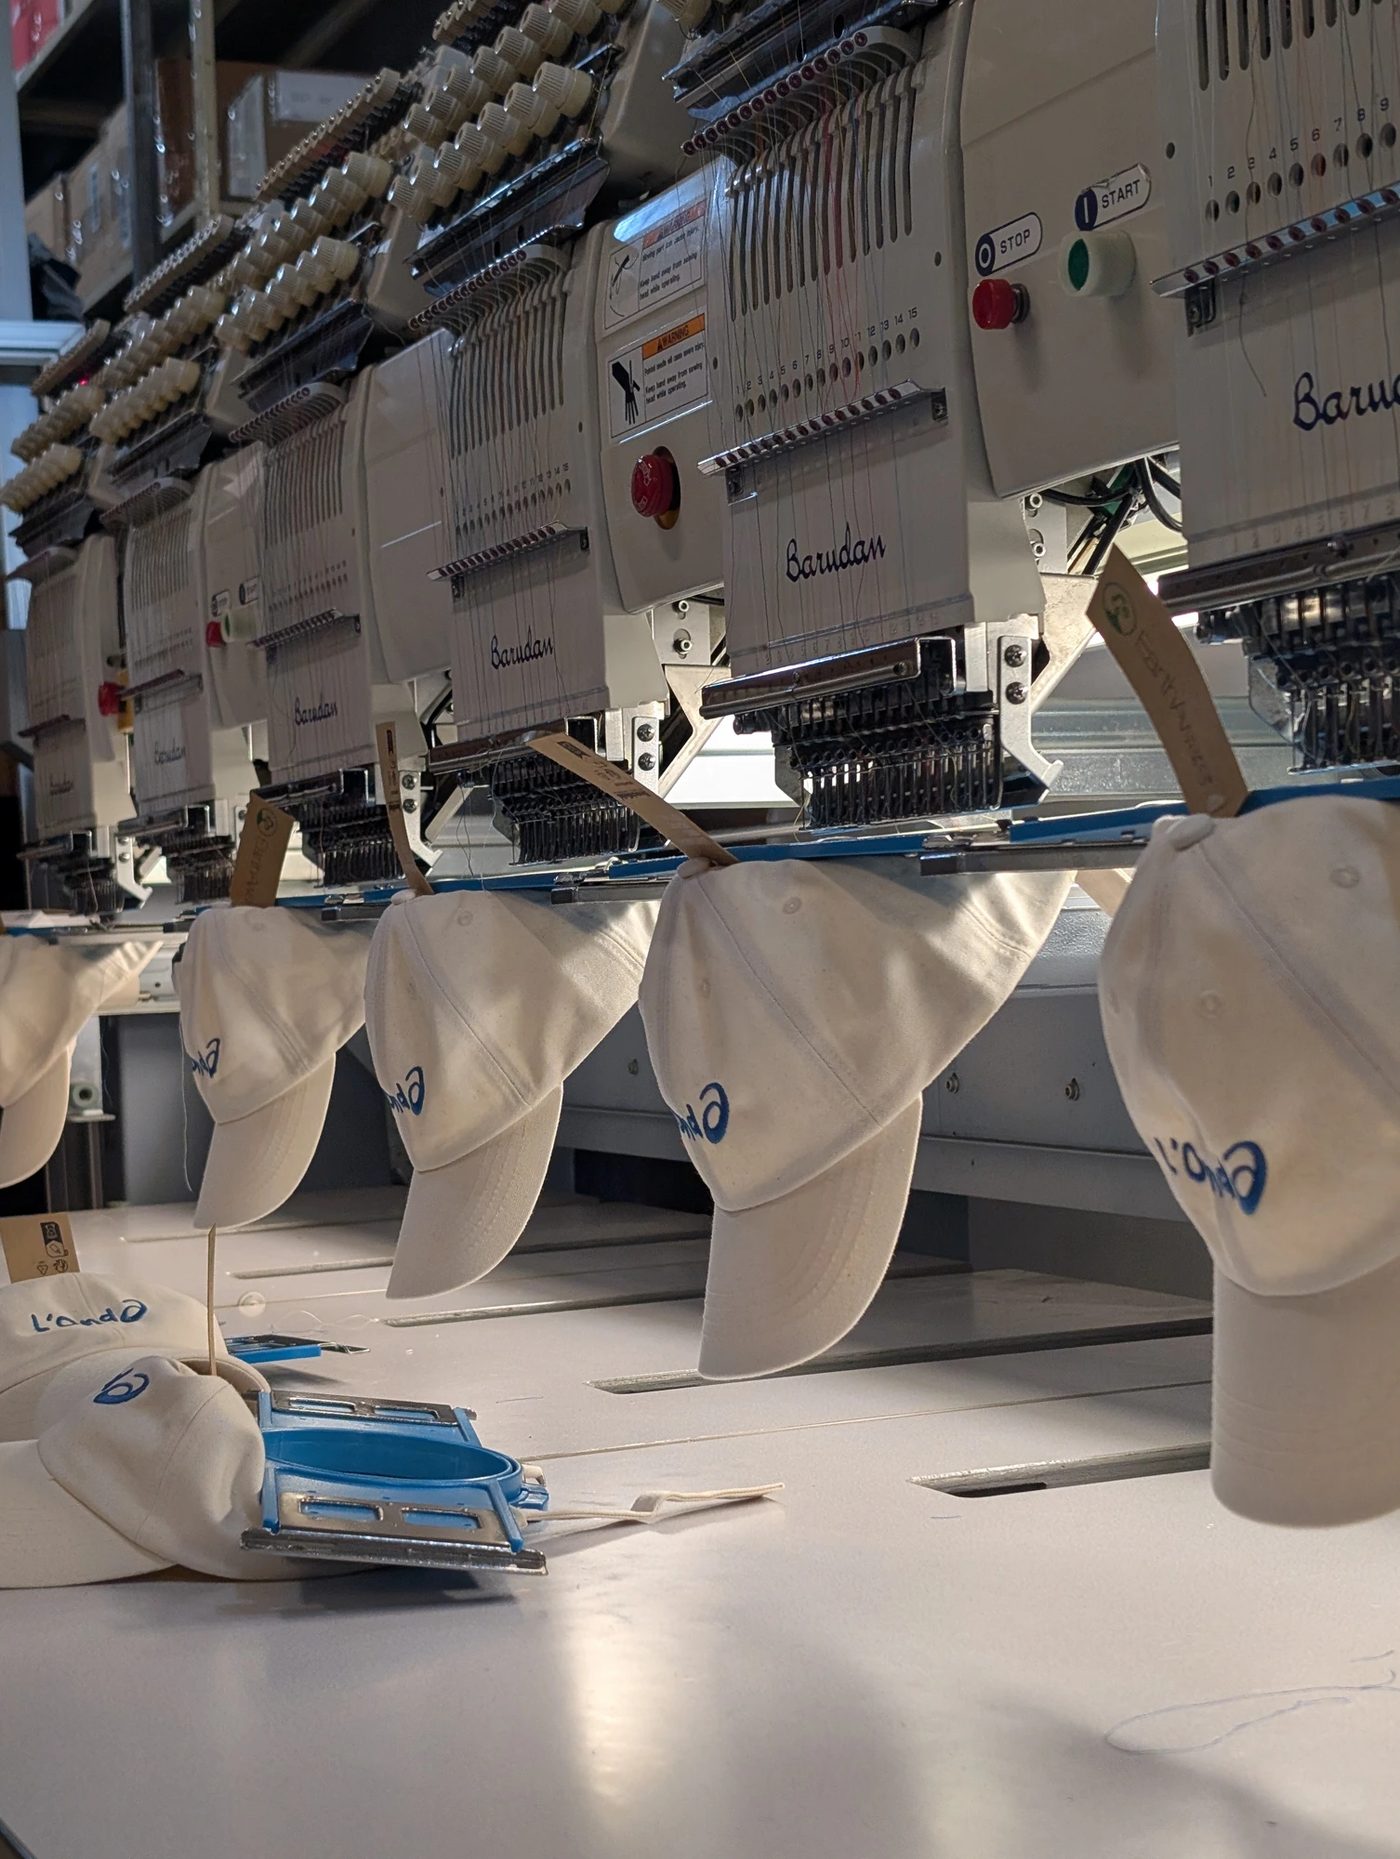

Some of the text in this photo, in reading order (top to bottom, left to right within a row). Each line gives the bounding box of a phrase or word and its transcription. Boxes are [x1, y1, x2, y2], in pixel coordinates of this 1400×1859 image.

[1208, 97, 1390, 187] 1 2 3 4 5 6 7 8 9
[1102, 179, 1141, 209] START
[1000, 229, 1031, 254] STOP
[662, 324, 689, 347] WARNING
[746, 381, 752, 390] 2
[757, 376, 763, 385] 3
[769, 371, 774, 380] 4
[780, 365, 786, 375] 5
[792, 360, 798, 370] 6
[805, 355, 810, 365] 7
[816, 350, 822, 360] 8
[829, 344, 836, 354] 9
[840, 337, 850, 348] 10
[880, 320, 890, 330] 13
[894, 314, 904, 325] 14
[908, 307, 918, 319] 15
[786, 521, 886, 582] Barudan
[491, 624, 554, 670] Barudan
